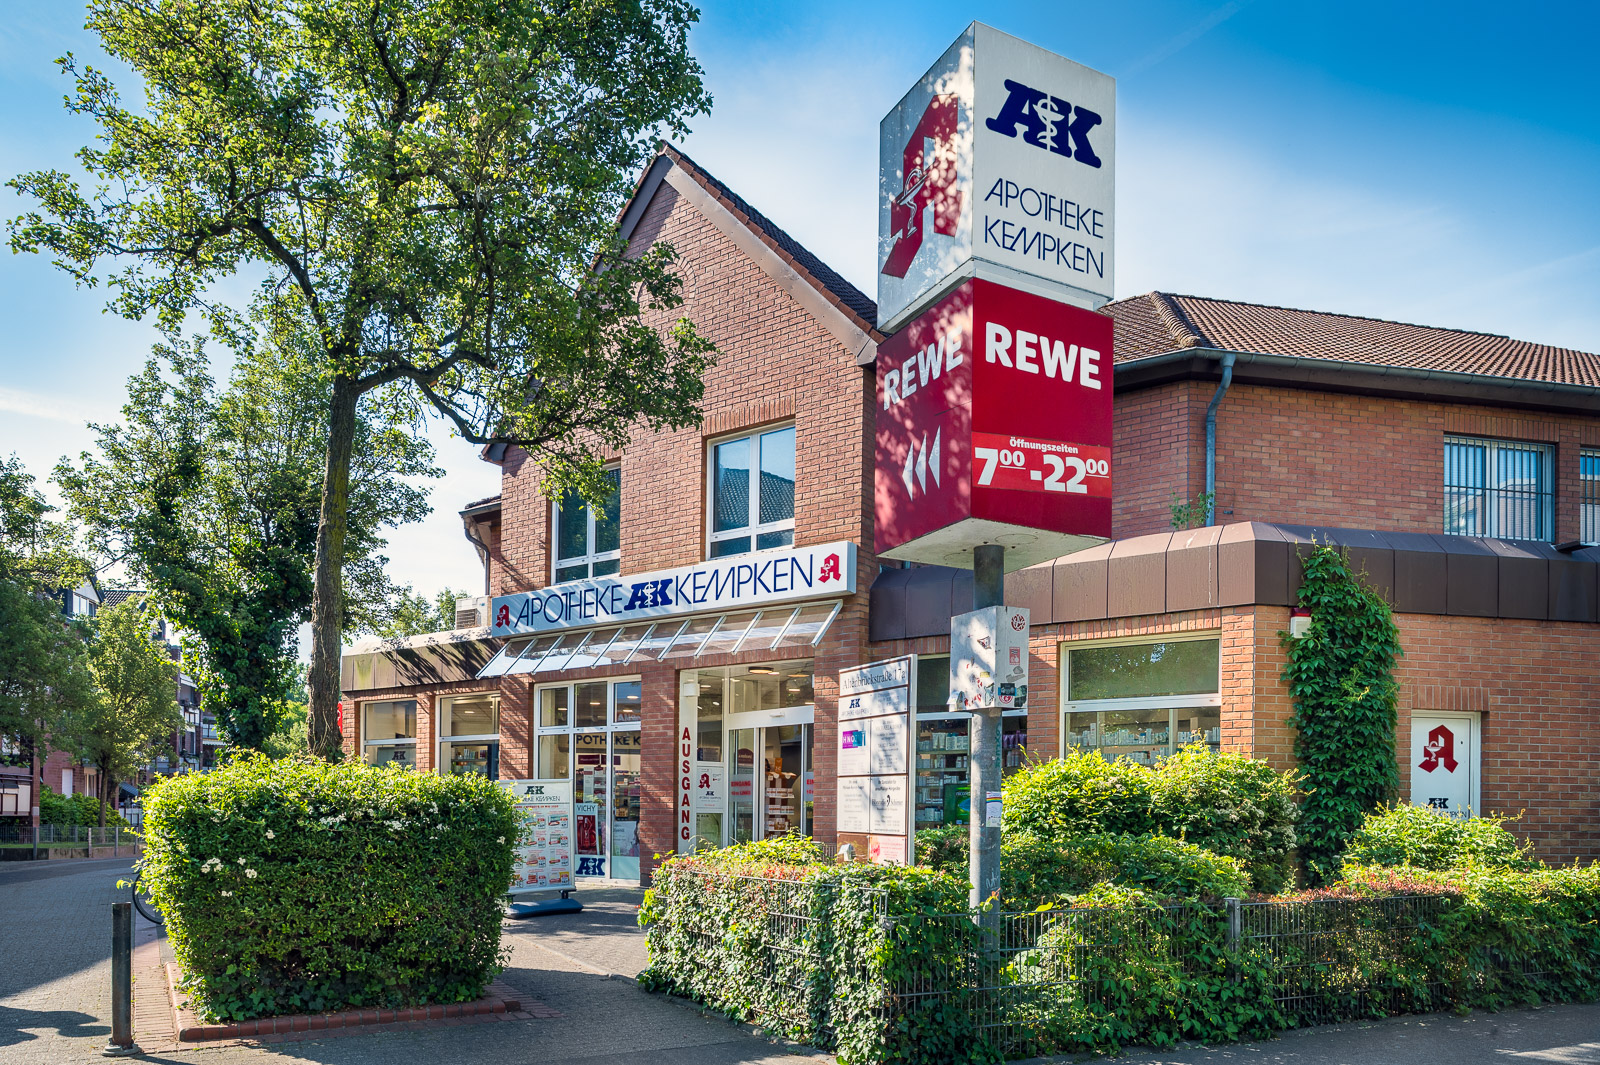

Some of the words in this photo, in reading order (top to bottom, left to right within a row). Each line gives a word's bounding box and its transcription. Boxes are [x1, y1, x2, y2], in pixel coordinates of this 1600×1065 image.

[984, 177, 1104, 239] APOTHEKE
[984, 215, 1104, 279] KEMPKEN
[883, 324, 964, 411] REWE
[985, 321, 1102, 390] REWE
[1009, 436, 1079, 454] Öffnungszeiten
[514, 583, 623, 628] APOTHEKE
[674, 554, 814, 606] KEMPKEN
[576, 804, 596, 812] VICHY
[681, 727, 691, 840] AUSGANG
